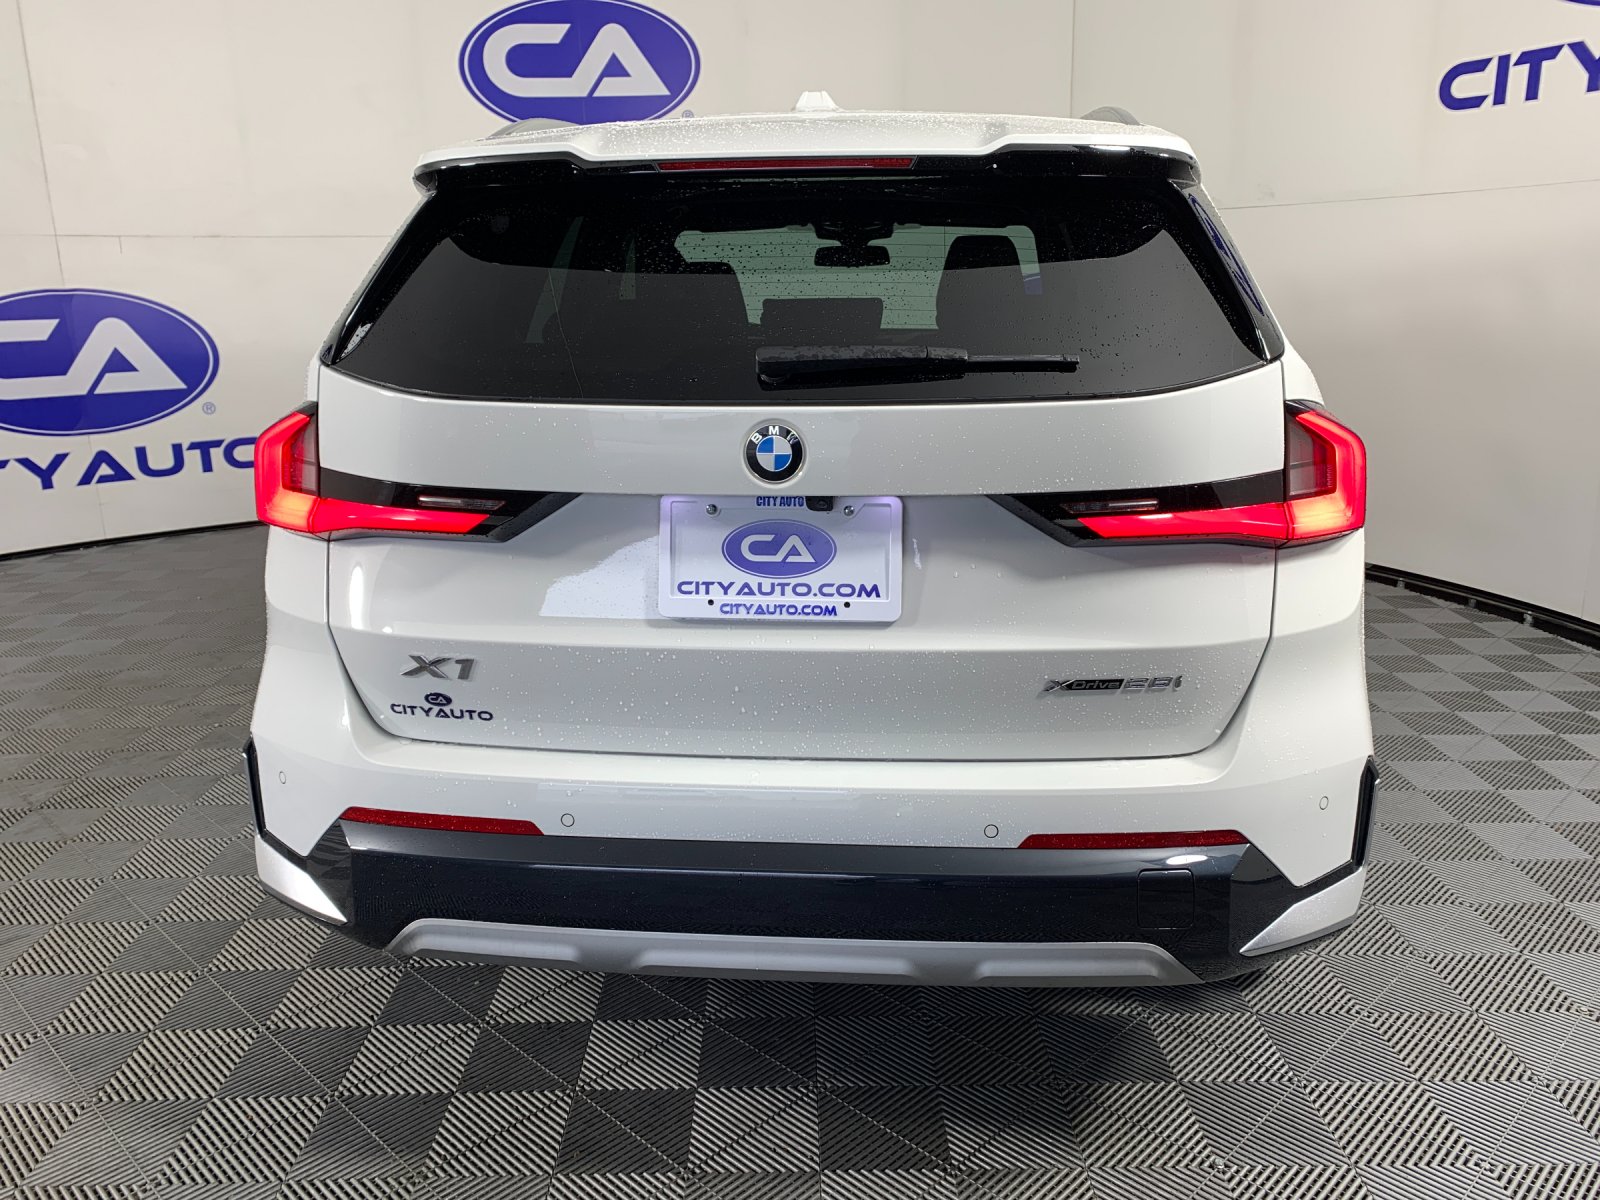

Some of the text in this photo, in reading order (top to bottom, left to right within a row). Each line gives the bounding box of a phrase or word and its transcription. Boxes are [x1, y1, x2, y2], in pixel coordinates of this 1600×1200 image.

[483, 23, 671, 98] CA
[1439, 40, 1600, 111] CITY
[751, 425, 799, 445] BMW
[756, 496, 804, 508] CITY AUTO
[740, 534, 816, 563] CA
[677, 580, 881, 598] CITYAUTO.COM
[719, 602, 837, 616] CITYAUTO.COM
[400, 654, 475, 680] X1
